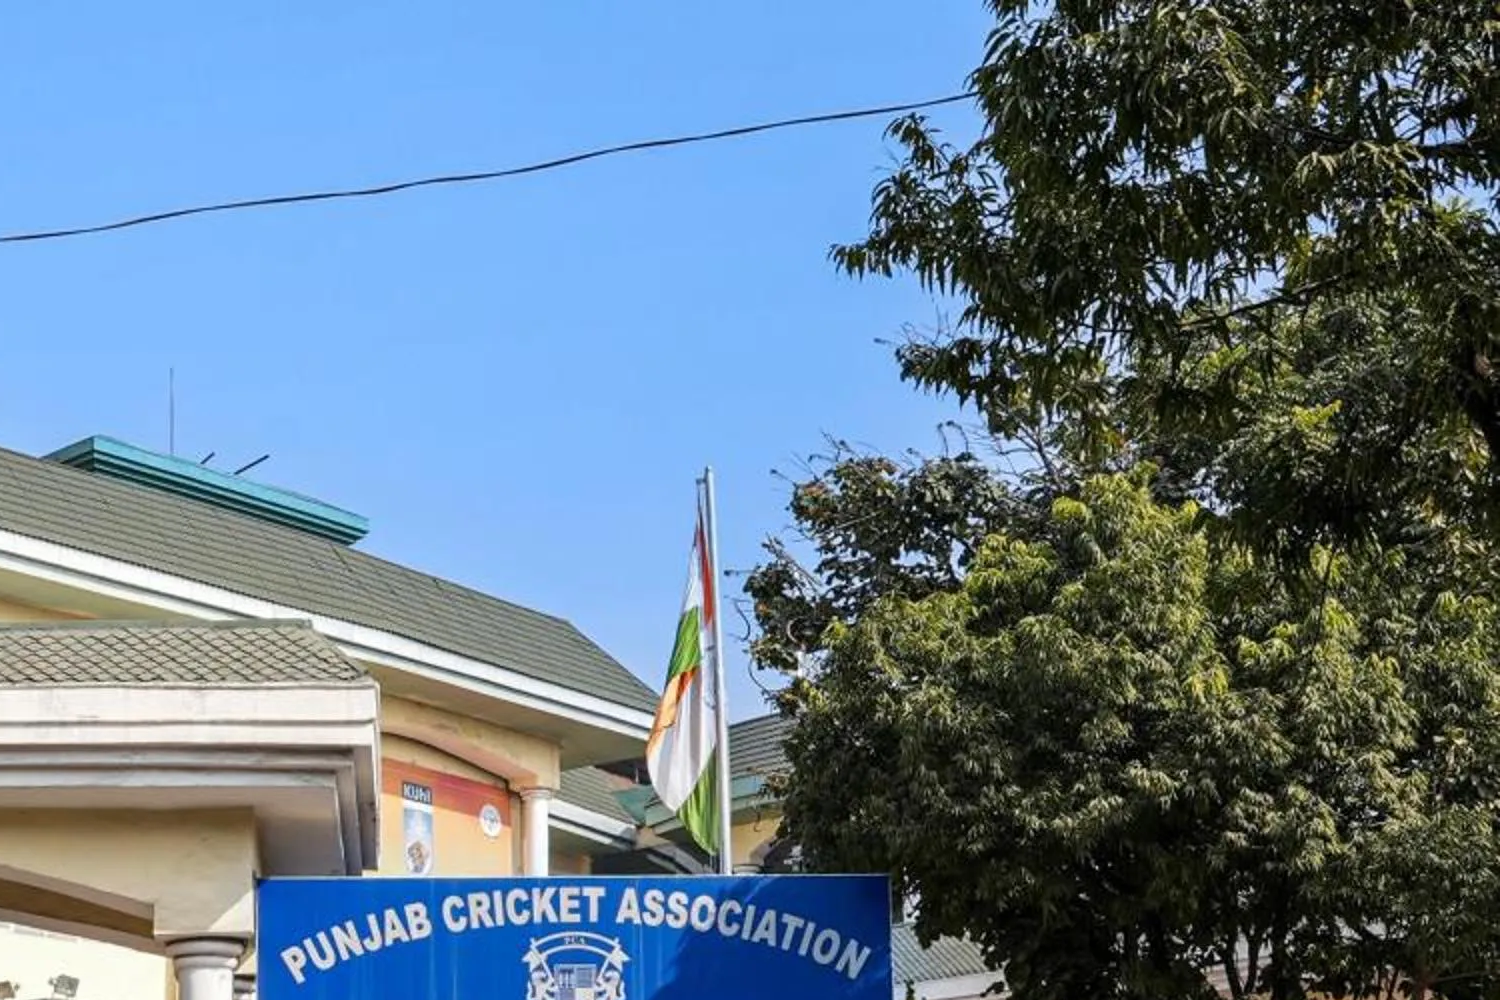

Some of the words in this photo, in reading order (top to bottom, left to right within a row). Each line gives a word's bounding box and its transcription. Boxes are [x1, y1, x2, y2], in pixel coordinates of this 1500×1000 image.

[280, 902, 432, 984] PUNJAB
[442, 887, 606, 933] CRICKET
[615, 887, 871, 980] ASSOCIATION
